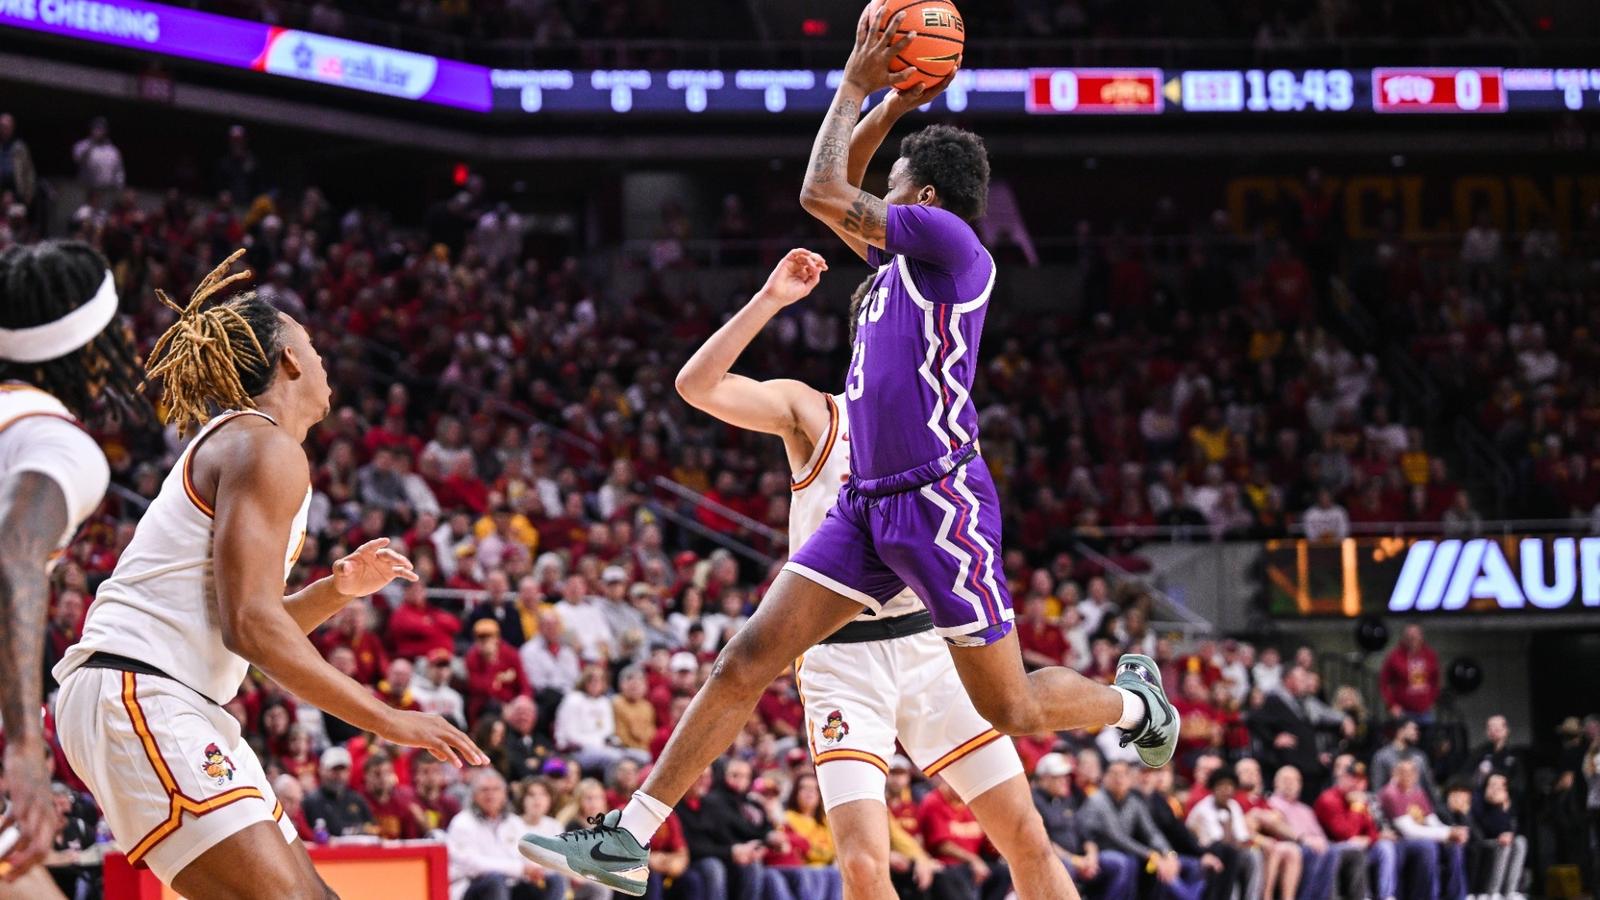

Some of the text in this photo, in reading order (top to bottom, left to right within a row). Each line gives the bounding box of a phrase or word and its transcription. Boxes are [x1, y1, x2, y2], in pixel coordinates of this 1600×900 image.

[39, 0, 160, 43] CHEERING
[922, 8, 963, 33] ELITE
[1049, 70, 1079, 112] 0
[1245, 69, 1354, 111] 19:43
[1454, 69, 1482, 111] 0
